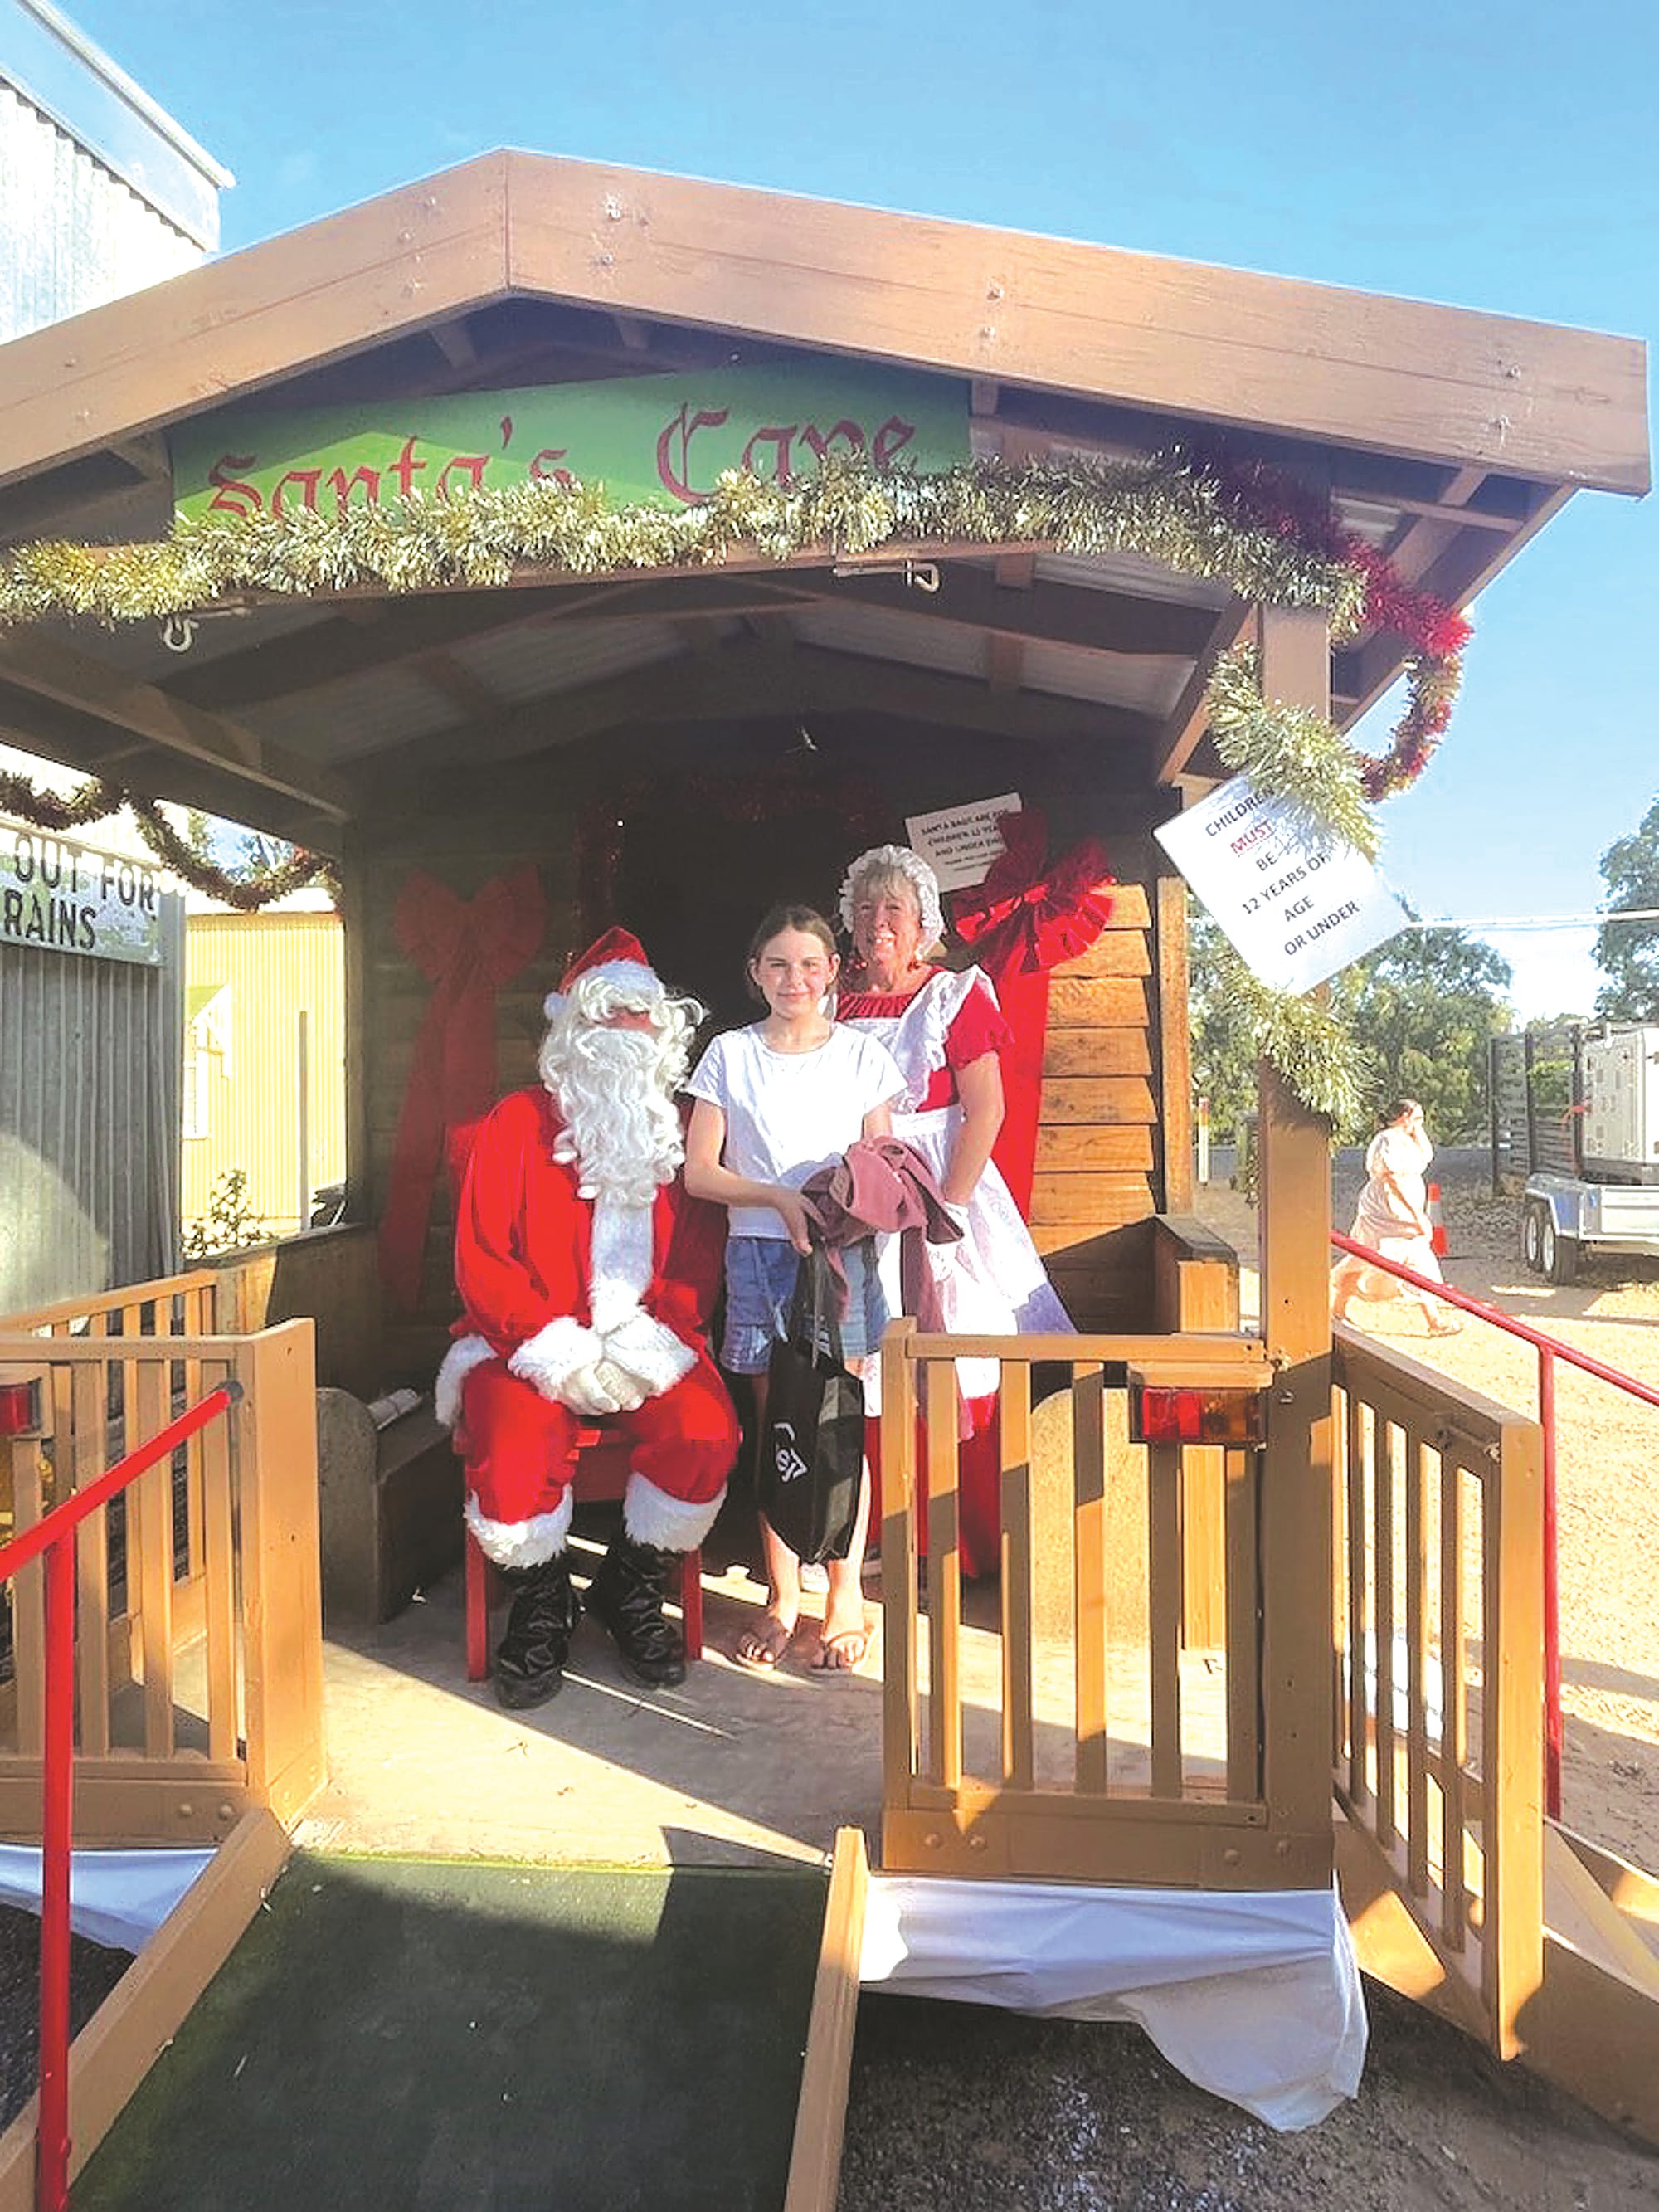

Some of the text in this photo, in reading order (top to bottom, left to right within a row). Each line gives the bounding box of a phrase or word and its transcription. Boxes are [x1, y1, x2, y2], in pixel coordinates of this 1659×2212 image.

[1229, 820, 1274, 853] MUST
[14, 832, 155, 911] OUT FOR
[1256, 850, 1277, 871] BE
[1241, 897, 1262, 915] 12
[1260, 865, 1308, 903] YEARS
[1284, 895, 1316, 923] AGE
[1284, 900, 1360, 956] OR UNDER
